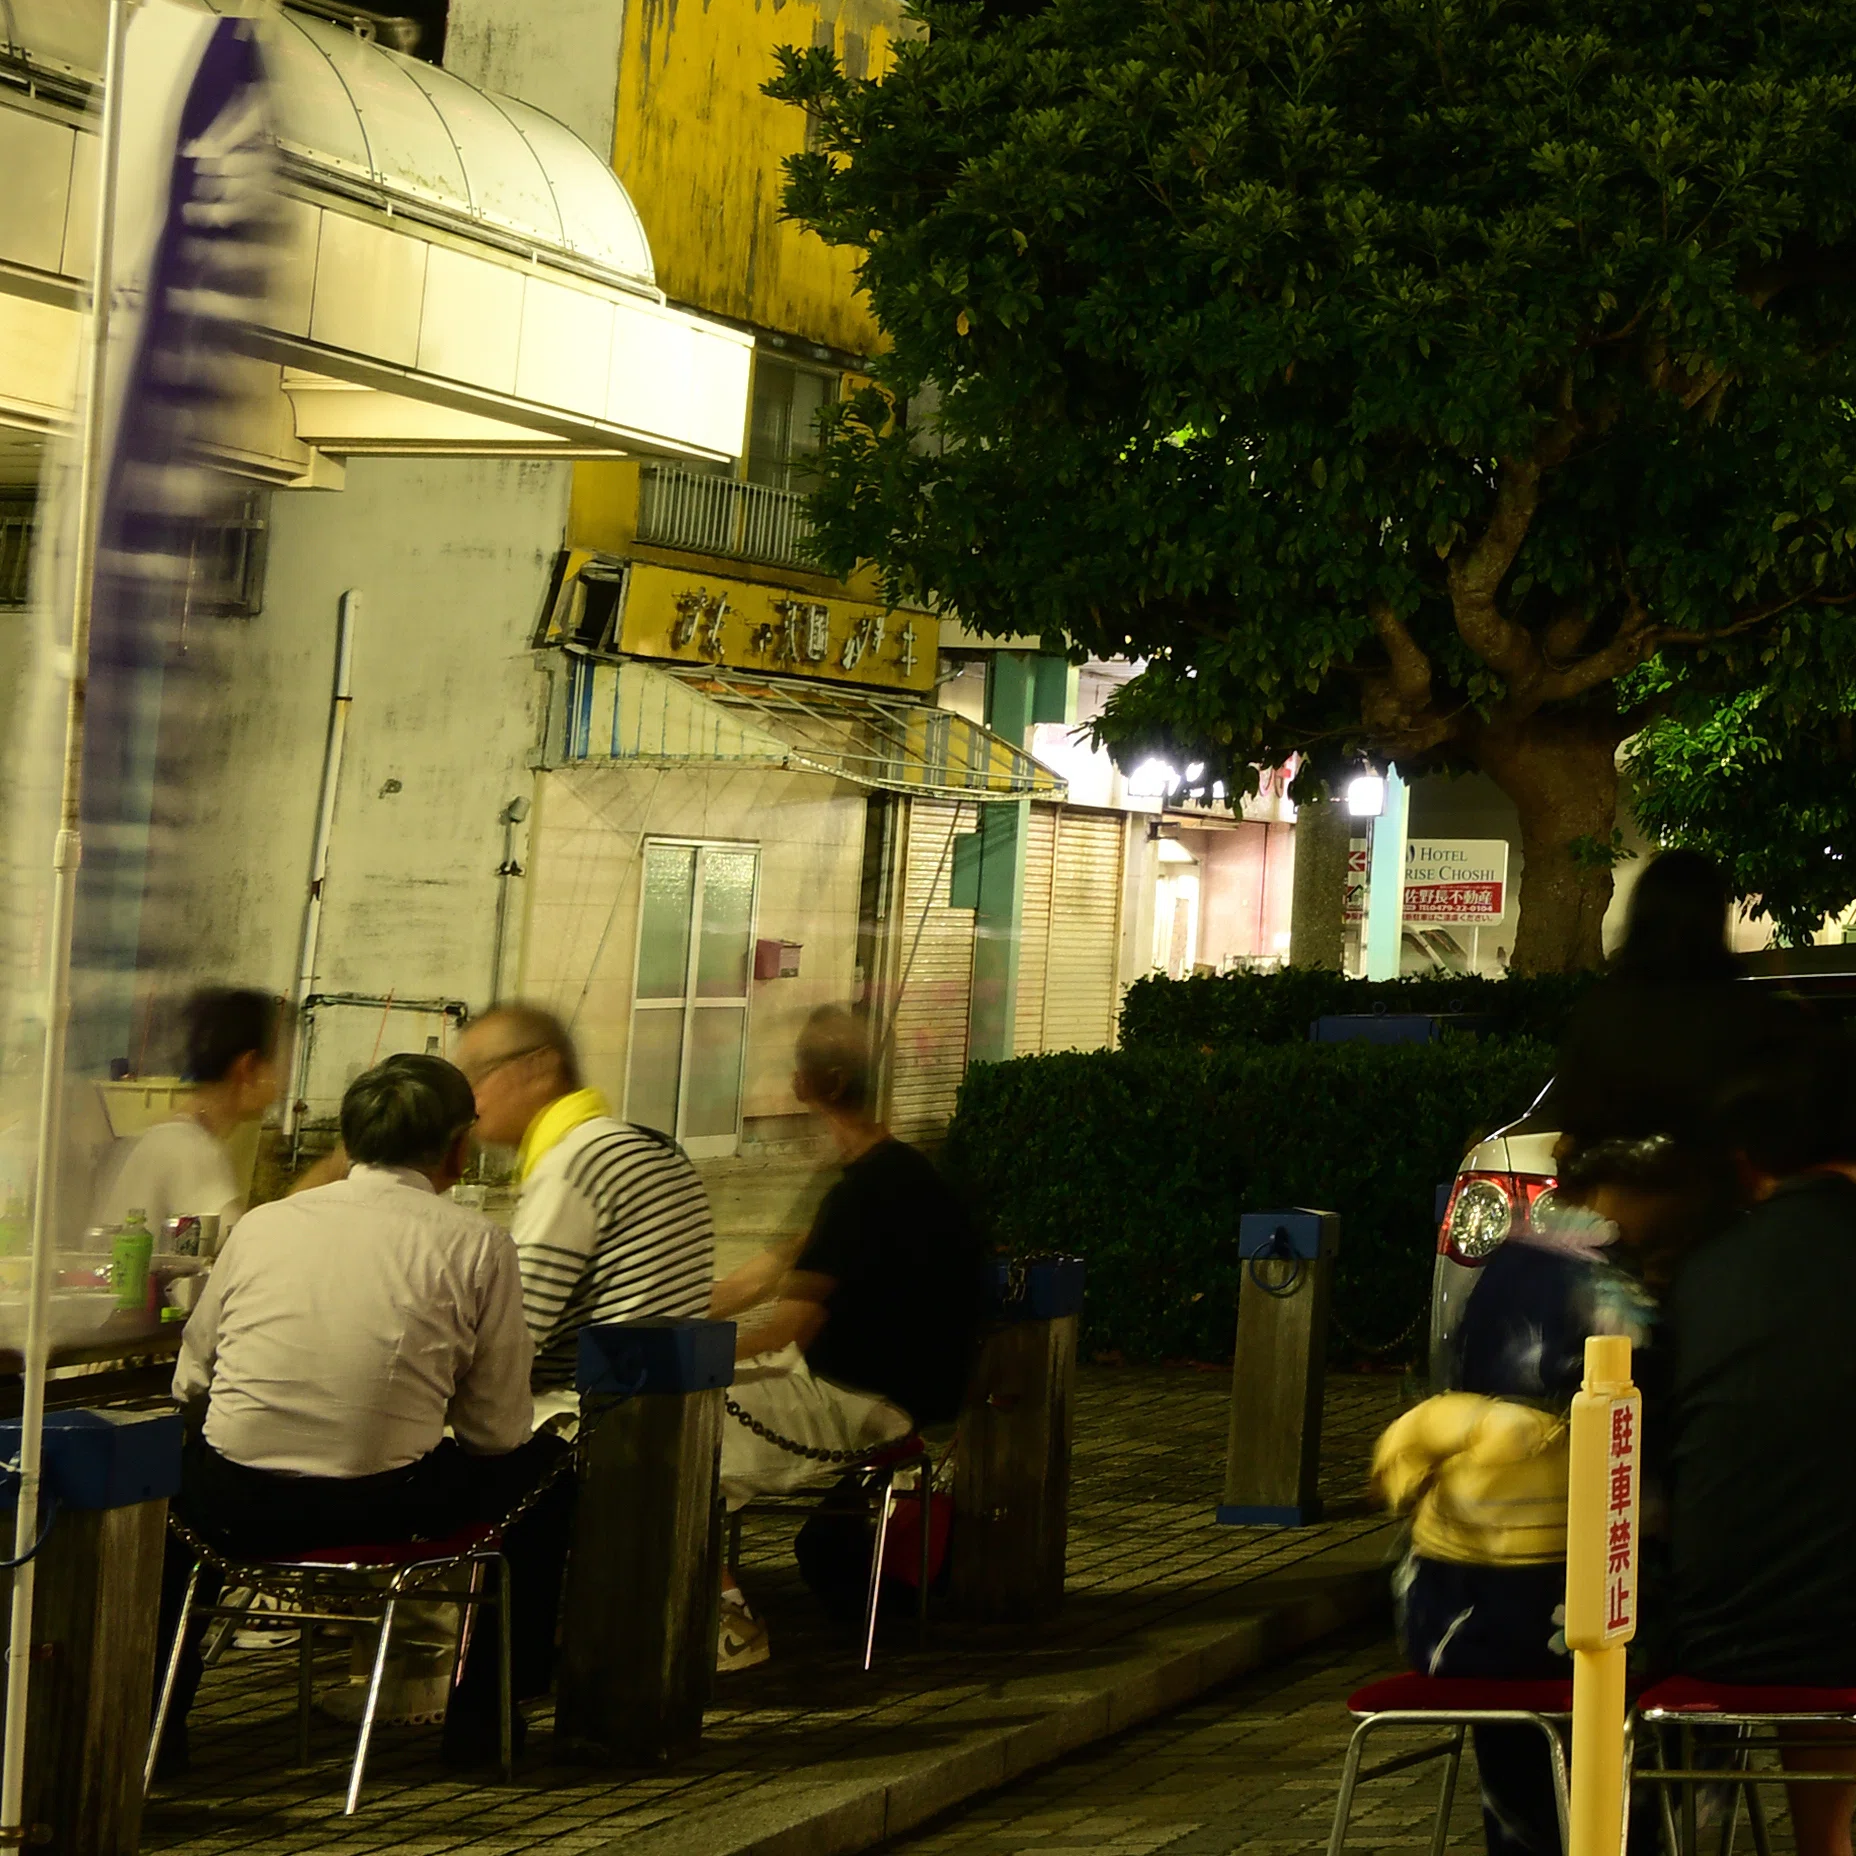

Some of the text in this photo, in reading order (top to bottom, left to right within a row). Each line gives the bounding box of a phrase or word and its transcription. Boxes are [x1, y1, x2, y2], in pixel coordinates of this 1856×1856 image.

[1420, 847, 1468, 862] HOTEL
[1405, 866, 1495, 881] RISE CHOSHI
[1607, 1406, 1633, 1630] 駐車禁止
